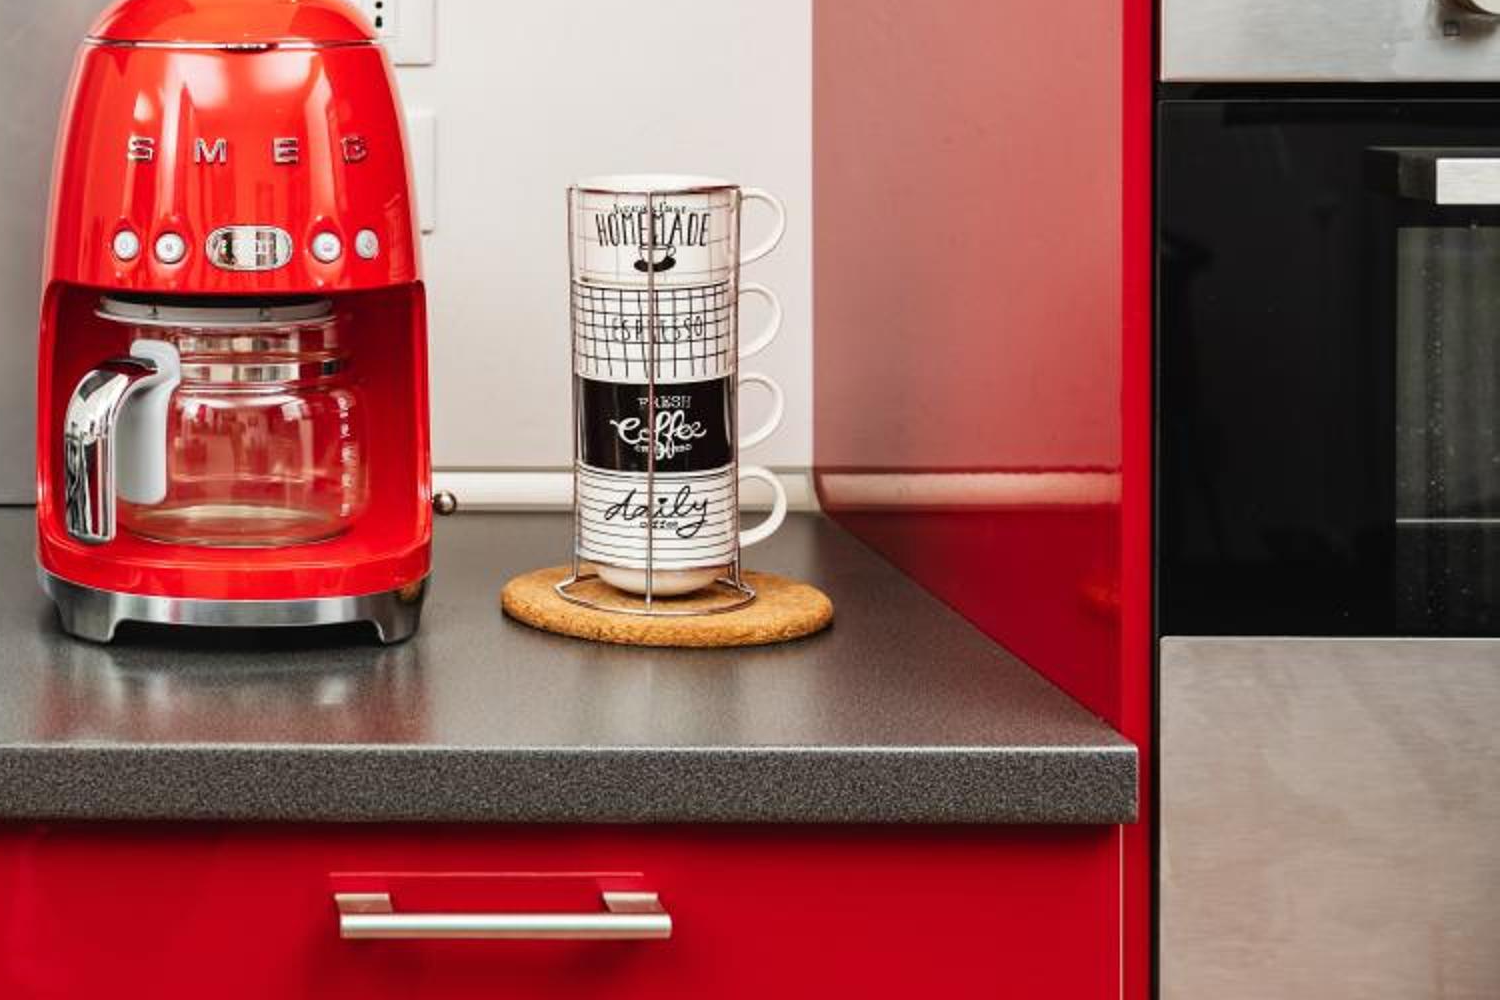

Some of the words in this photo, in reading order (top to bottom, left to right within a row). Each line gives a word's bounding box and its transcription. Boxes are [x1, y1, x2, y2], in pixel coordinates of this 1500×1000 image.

[126, 136, 369, 165] SMEG
[609, 409, 707, 460] Coffee
[604, 485, 708, 538] daily
